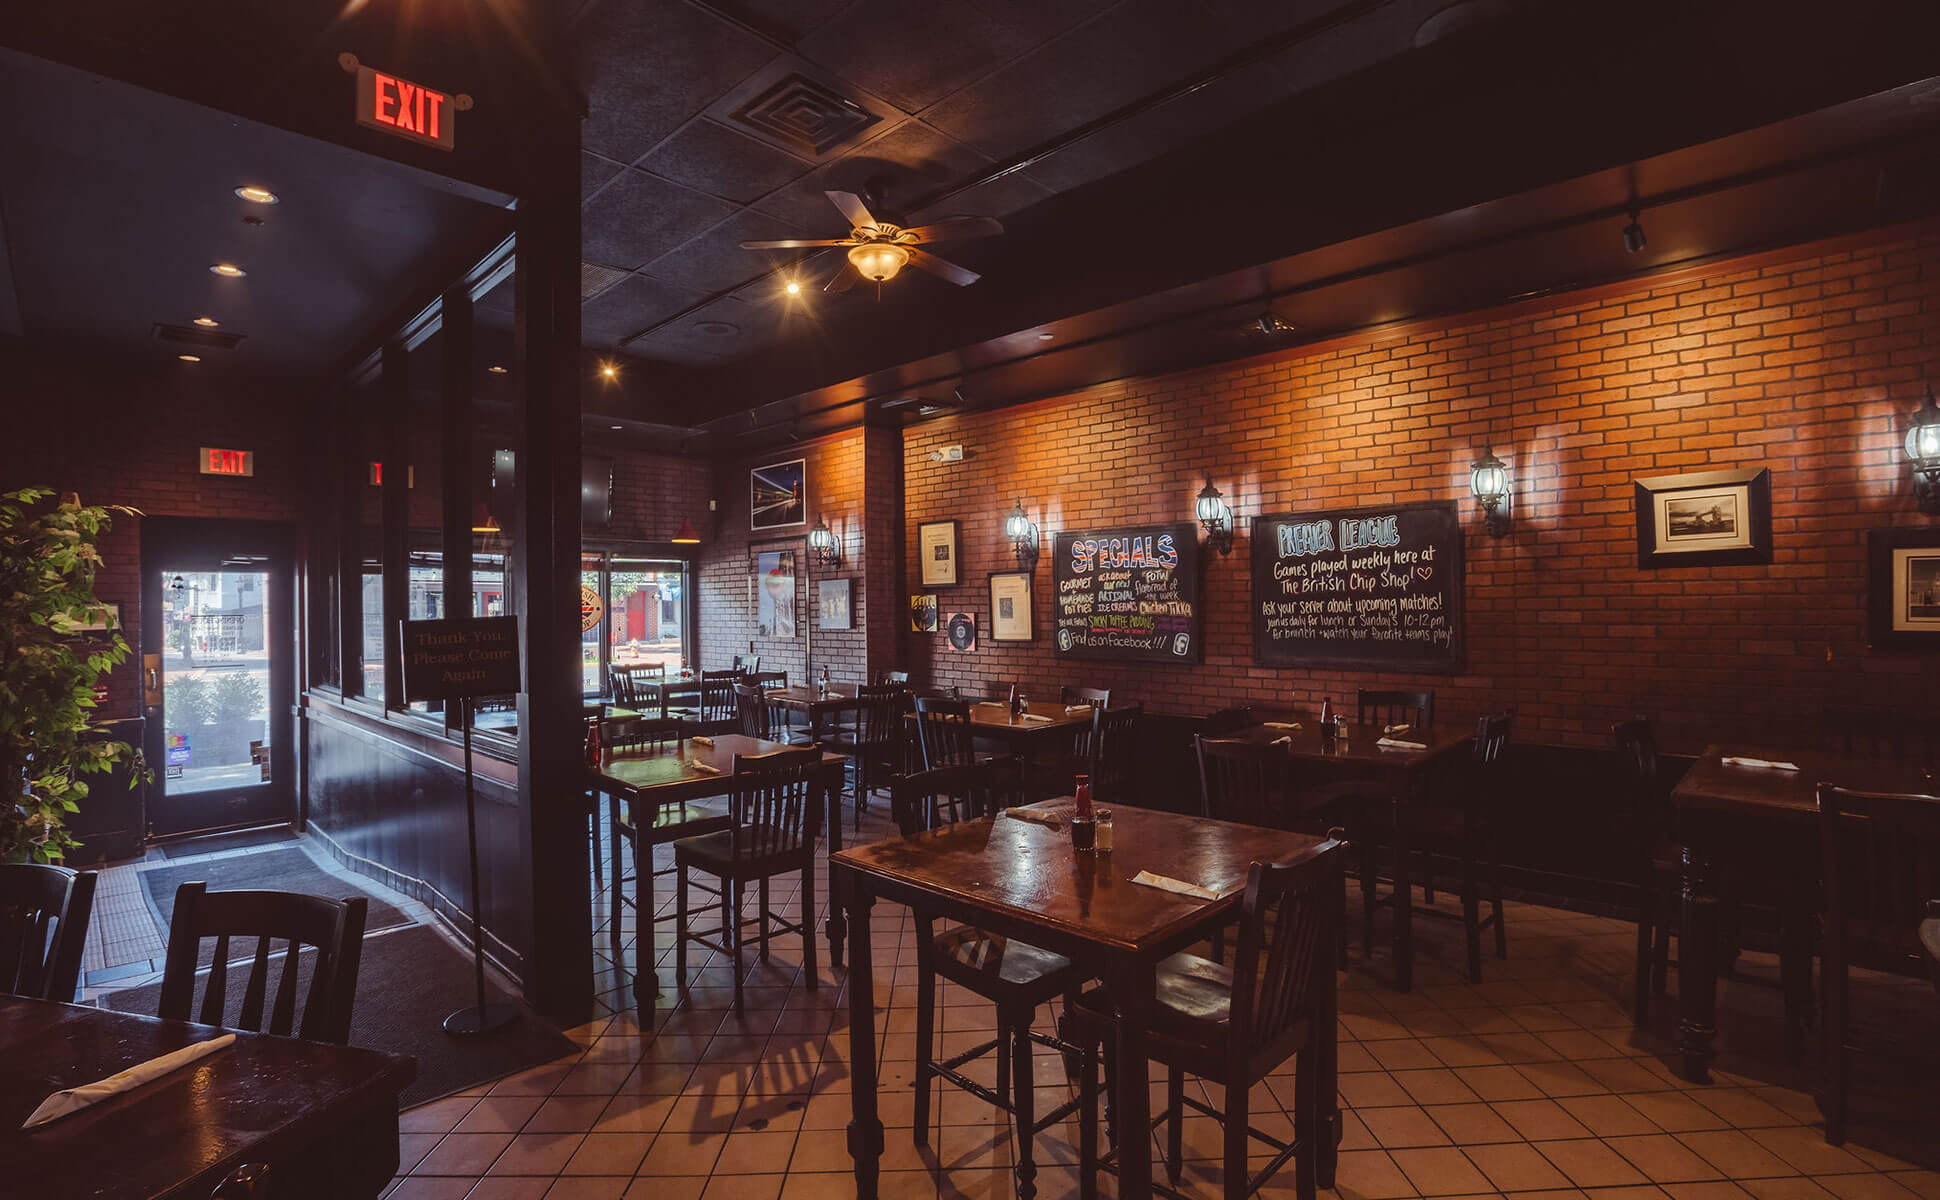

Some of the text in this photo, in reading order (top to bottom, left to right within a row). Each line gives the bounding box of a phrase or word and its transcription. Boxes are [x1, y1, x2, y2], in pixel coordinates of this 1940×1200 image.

[375, 73, 444, 139] EXIT
[209, 449, 246, 474] EXIT
[1278, 516, 1400, 558] PREMIER LEAGUE
[1072, 535, 1178, 573] SPECIALS
[1274, 545, 1436, 580] Games played weekly here at
[1281, 566, 1415, 594] The British Chip Shop!
[1262, 592, 1442, 618] Ask your server about upcoming matches!
[1320, 614, 1345, 627] lunch
[416, 632, 466, 645] Thank
[1071, 629, 1087, 645] Find
[1088, 636, 1097, 647] us
[414, 648, 511, 665] Please Come
[443, 671, 487, 682] Again
